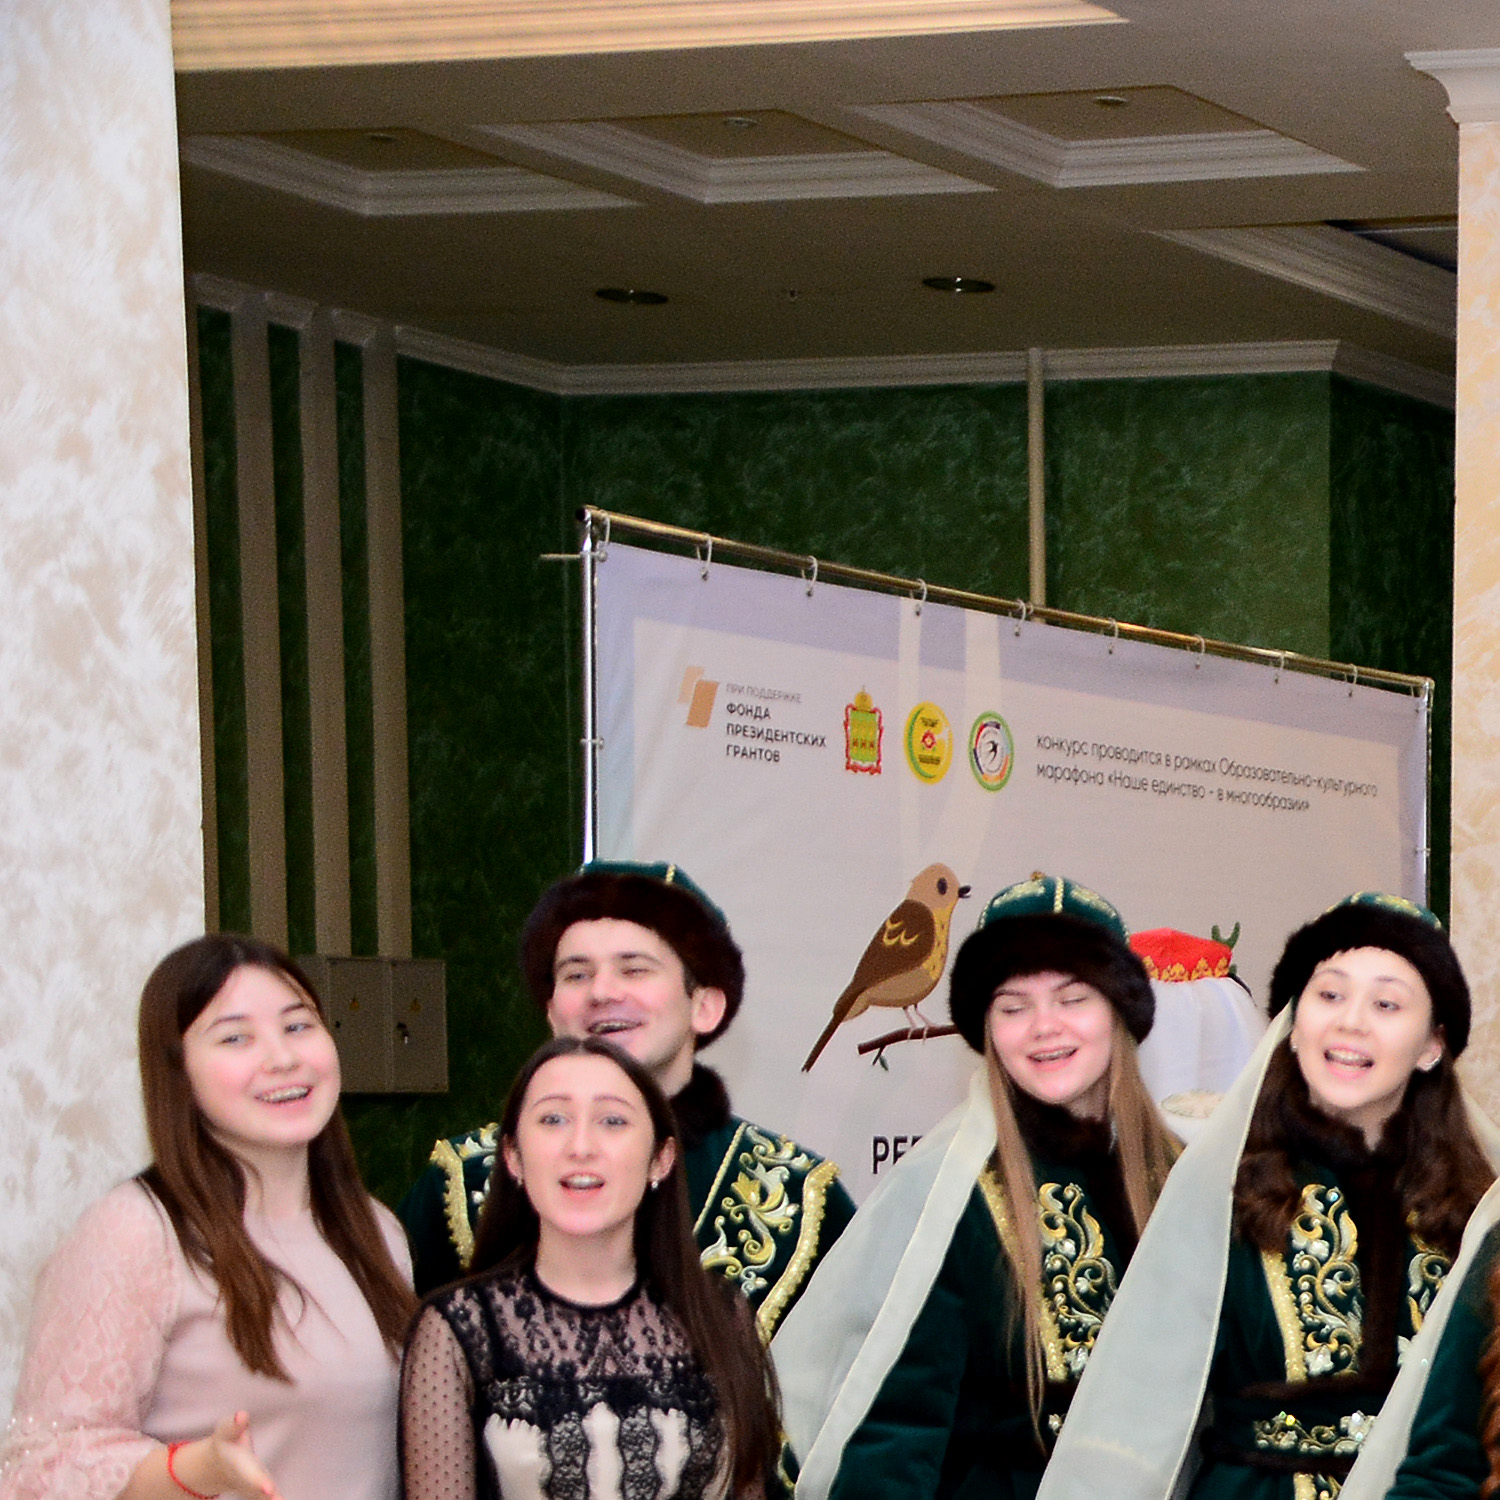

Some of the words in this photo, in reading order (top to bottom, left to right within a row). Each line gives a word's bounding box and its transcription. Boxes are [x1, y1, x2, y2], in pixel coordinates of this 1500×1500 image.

[726, 702, 771, 721] ФОНДА
[726, 722, 827, 748] ПРЕЗИДЕНТСКИХ
[726, 744, 781, 763] ГРАНТОВ
[1036, 734, 1088, 757] конкурс
[1092, 741, 1162, 766] проводится
[1165, 753, 1172, 767] в
[1174, 755, 1216, 774] рамках
[1219, 757, 1378, 798] Образовательно-культурного
[1036, 762, 1104, 787] марафона
[1108, 769, 1148, 792] «Наше
[1151, 778, 1205, 800] единство
[1217, 788, 1225, 802] в
[1226, 789, 1310, 813] многообразии»
[872, 1135, 923, 1175] РЕ
